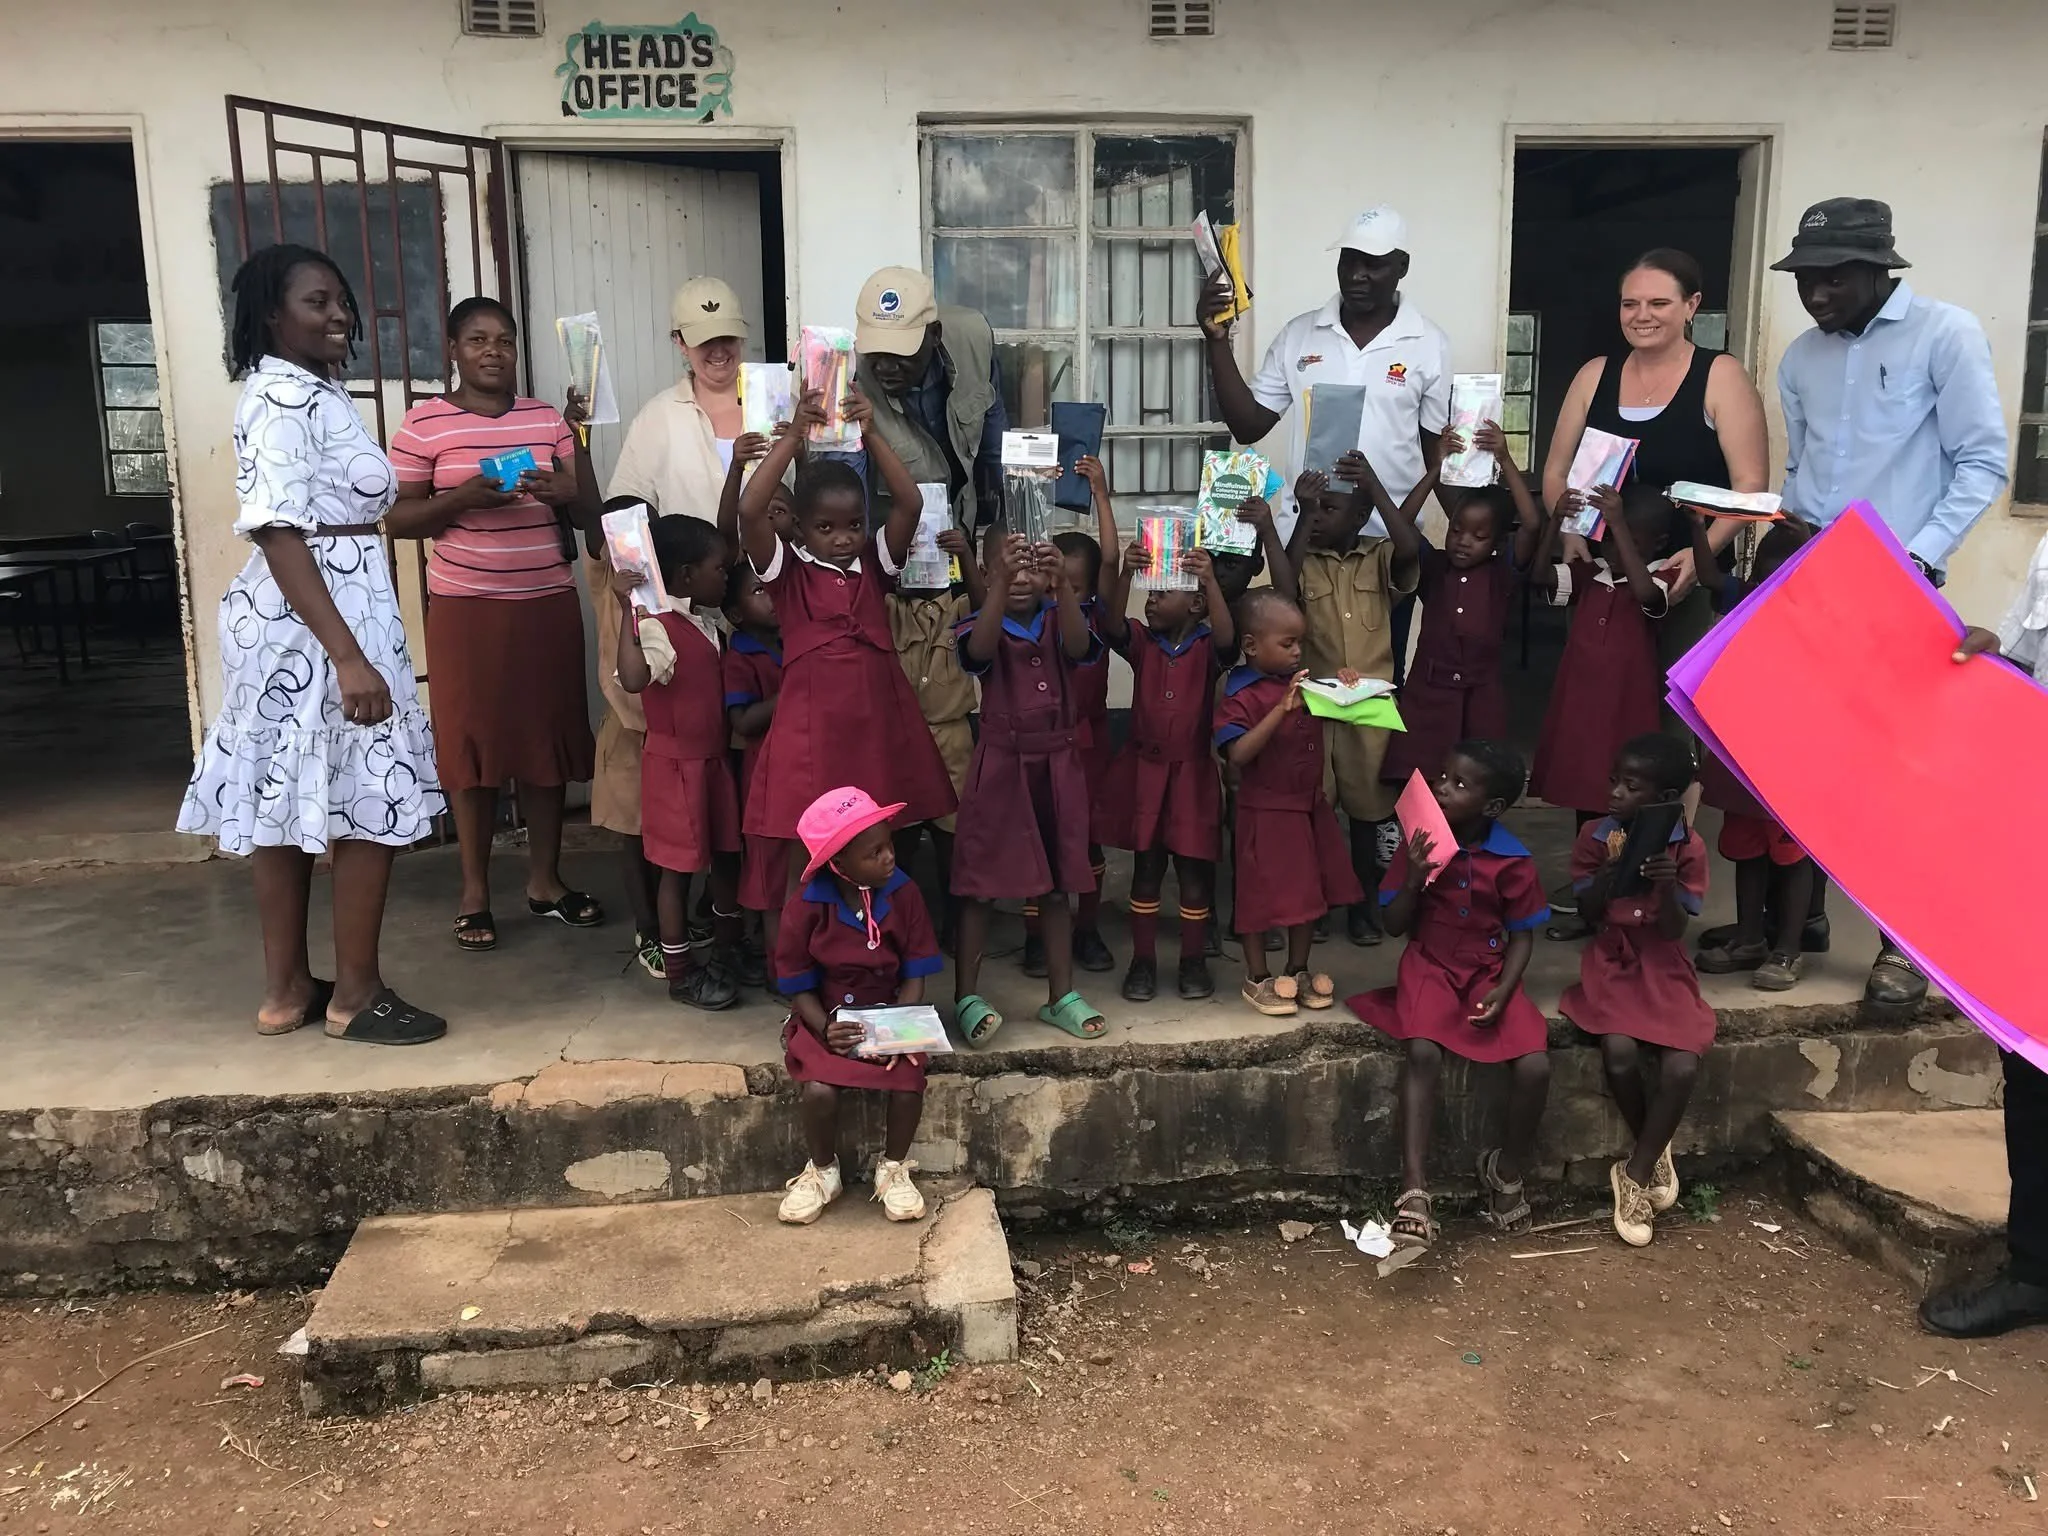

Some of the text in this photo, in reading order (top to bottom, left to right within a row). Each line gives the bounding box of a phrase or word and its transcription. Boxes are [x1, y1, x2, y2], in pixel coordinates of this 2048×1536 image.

[583, 29, 713, 69] HEAD'S
[575, 73, 697, 109] OFFICE
[1214, 481, 1251, 490] Mindfulness
[1215, 487, 1239, 495] Colouring
[1211, 492, 1250, 500] WORDSEARC
